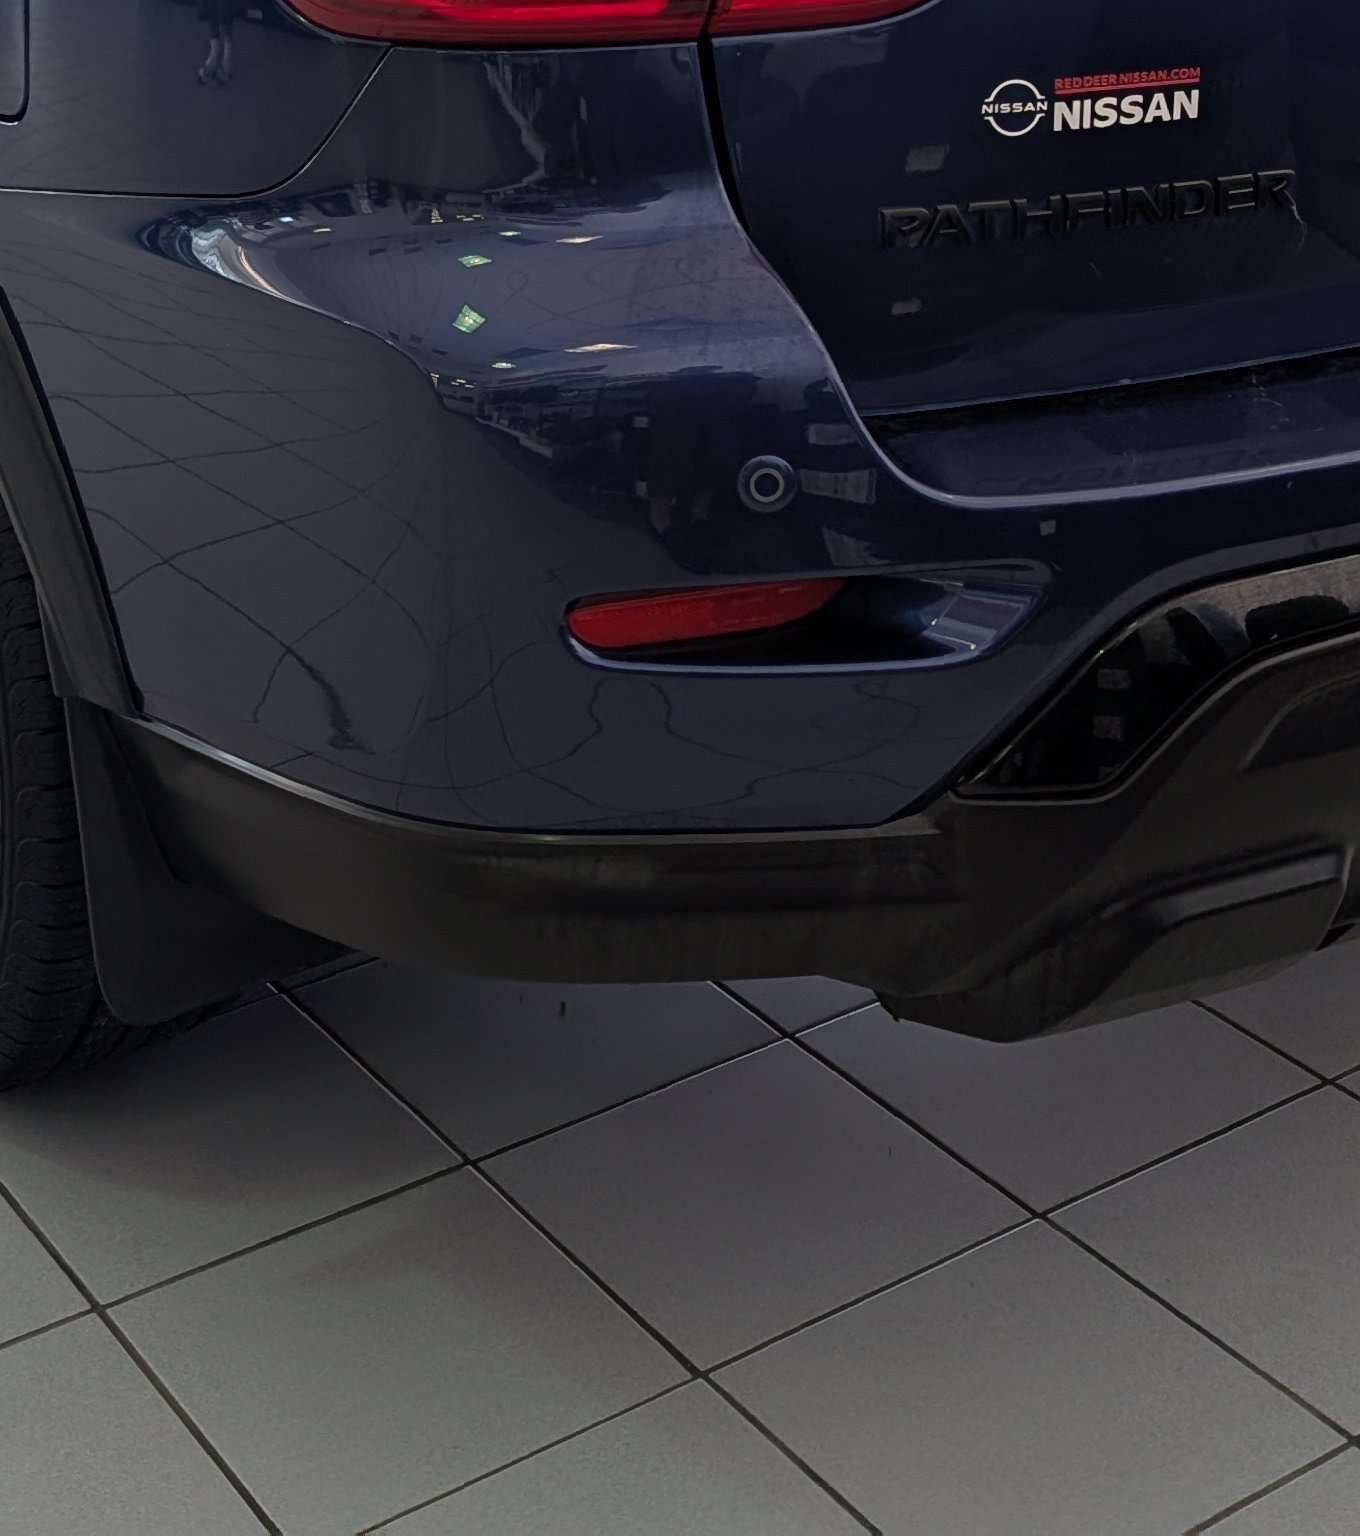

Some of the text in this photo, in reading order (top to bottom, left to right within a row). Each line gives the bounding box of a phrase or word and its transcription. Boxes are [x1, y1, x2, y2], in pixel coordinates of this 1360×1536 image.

[981, 100, 1048, 114] NISSAN
[1053, 88, 1200, 132] NISSAN
[879, 167, 1296, 249] PATHFINDER
